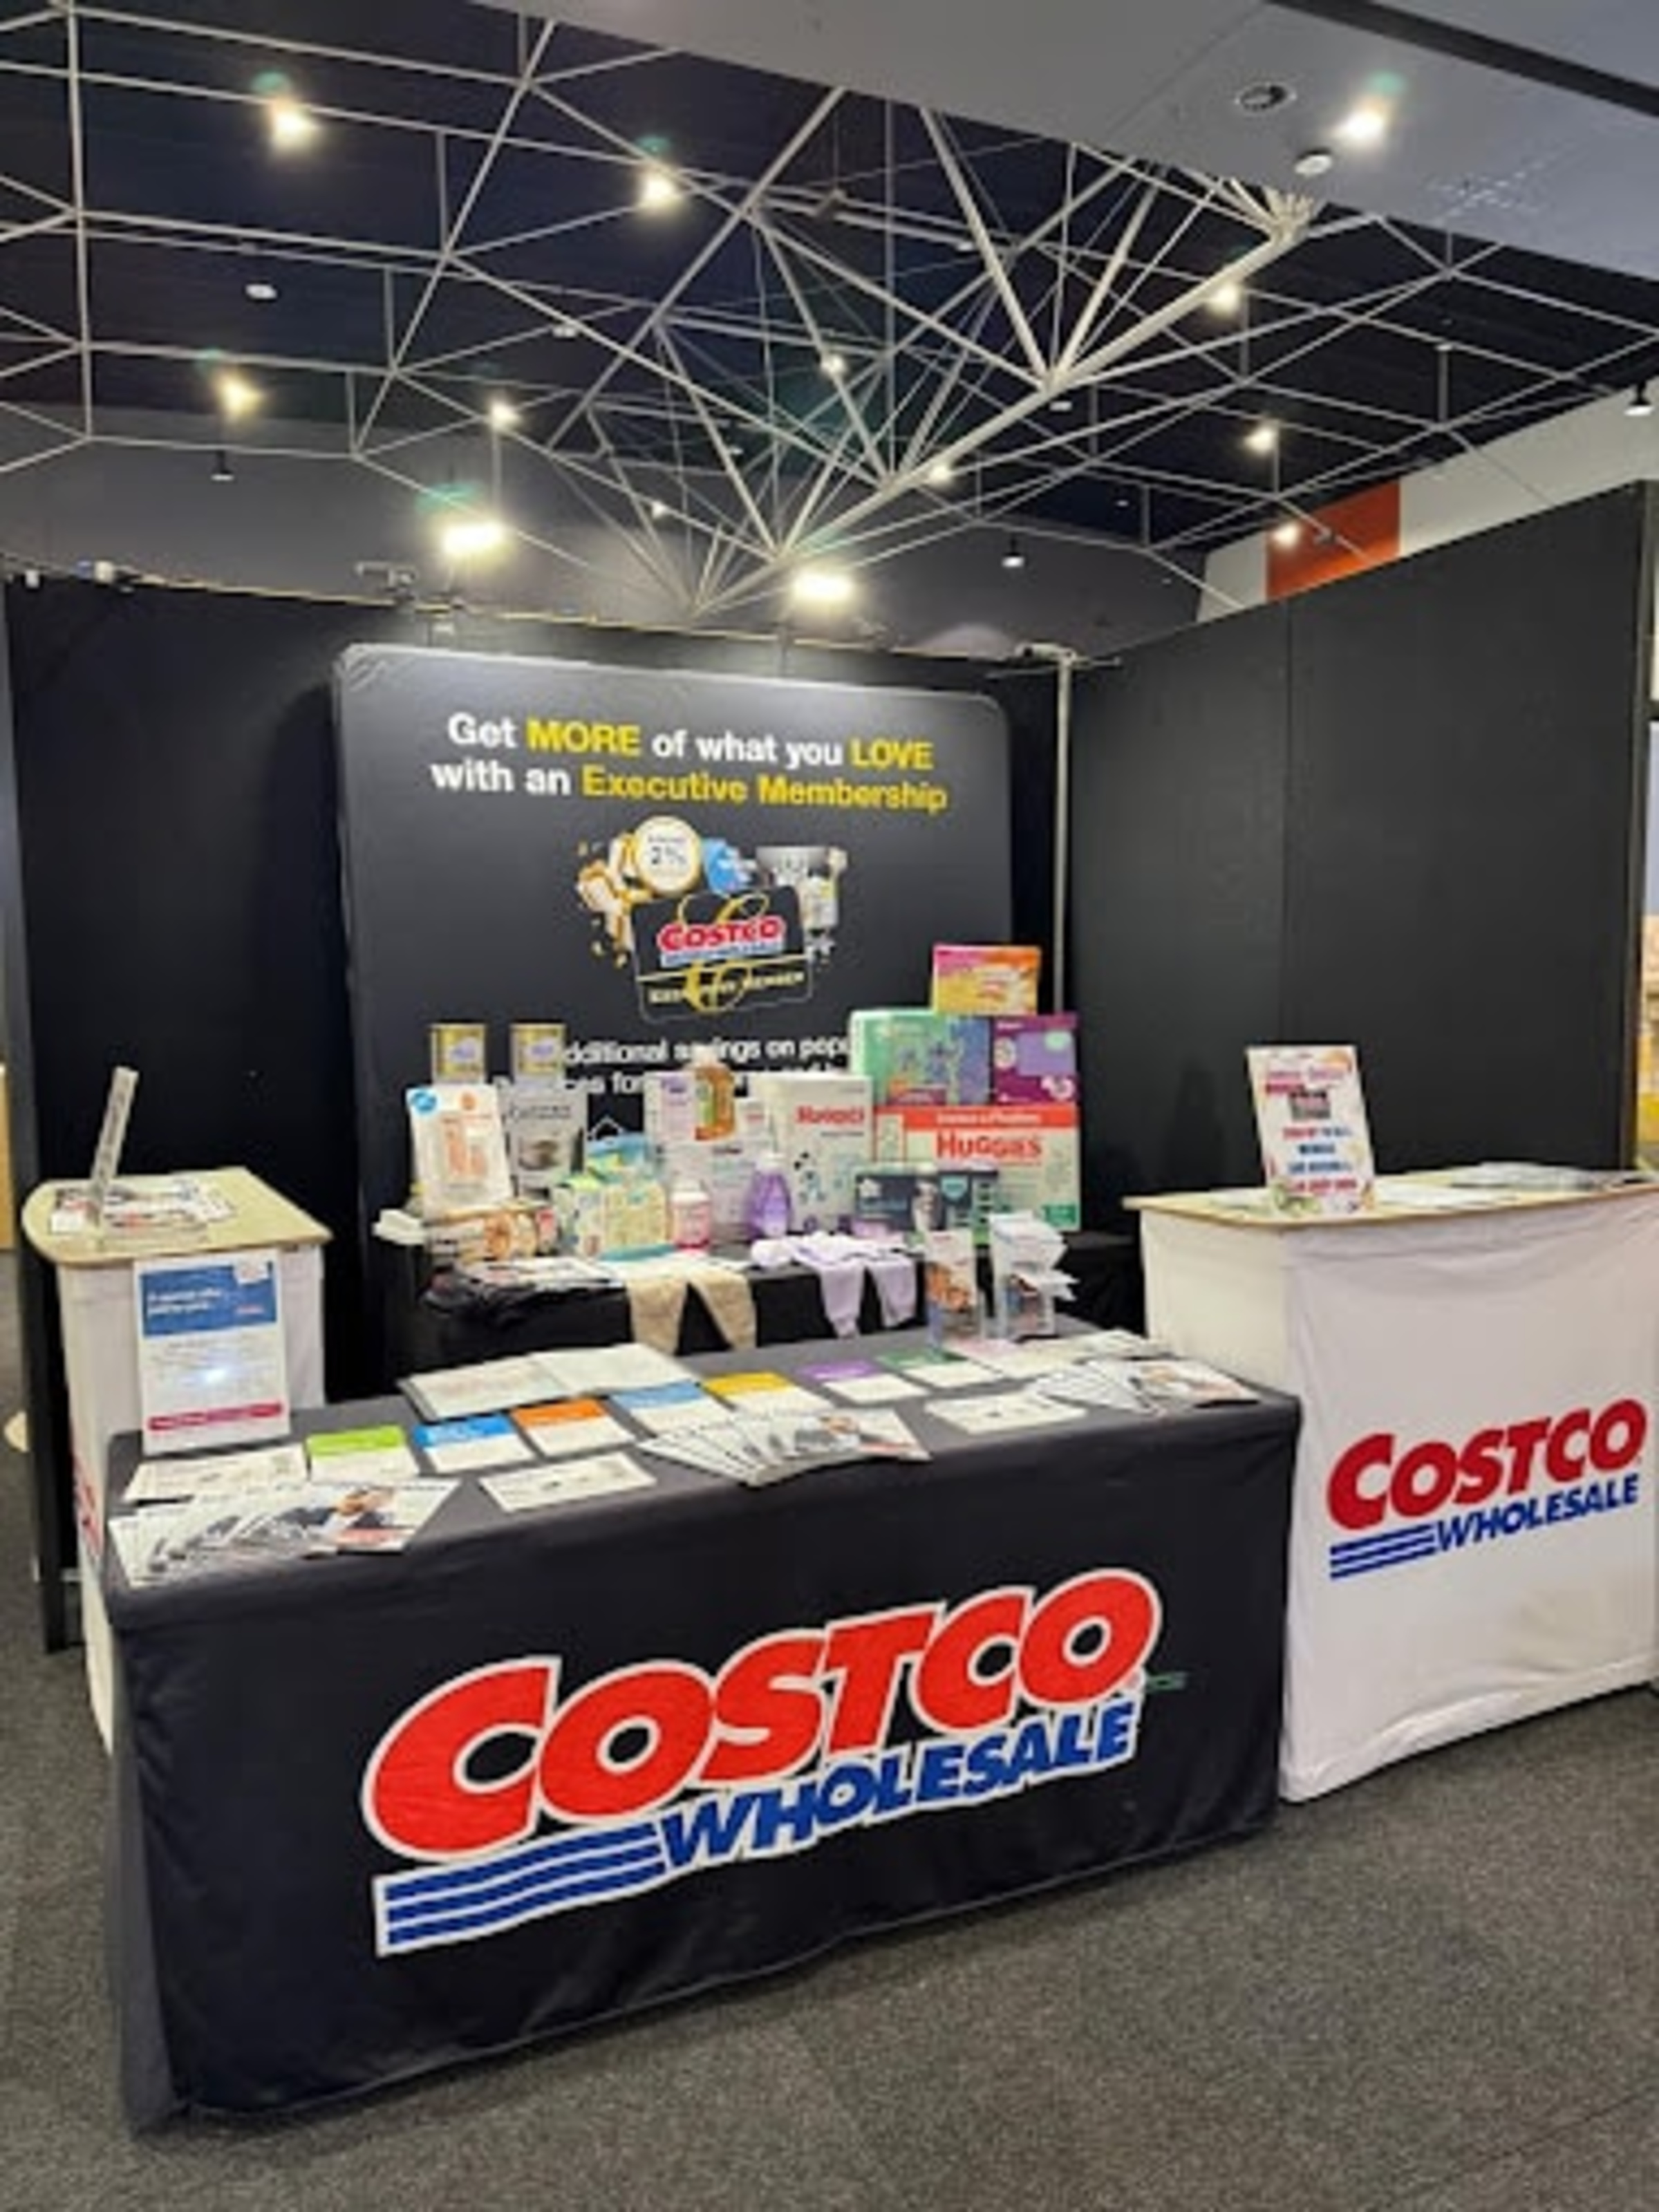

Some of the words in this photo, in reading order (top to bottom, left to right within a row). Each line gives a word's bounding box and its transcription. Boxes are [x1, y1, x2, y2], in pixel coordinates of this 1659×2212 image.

[449, 712, 517, 749] Get
[526, 719, 641, 757] MORE
[652, 729, 687, 758] of
[695, 731, 778, 762] what
[785, 741, 843, 770] you
[850, 738, 934, 771] LOVE
[431, 759, 515, 792] with
[525, 767, 571, 795] an
[581, 764, 747, 803] Executive
[758, 773, 948, 814] Membership
[659, 917, 784, 951] COSTCO
[564, 1038, 668, 1065] dditional
[765, 1041, 796, 1059] on
[1327, 1399, 1647, 1531] COSTCO
[1437, 1473, 1639, 1552] WHOLESALE
[368, 1573, 1157, 1856] COSTCO
[664, 1700, 1136, 1868] WHOLESALE
